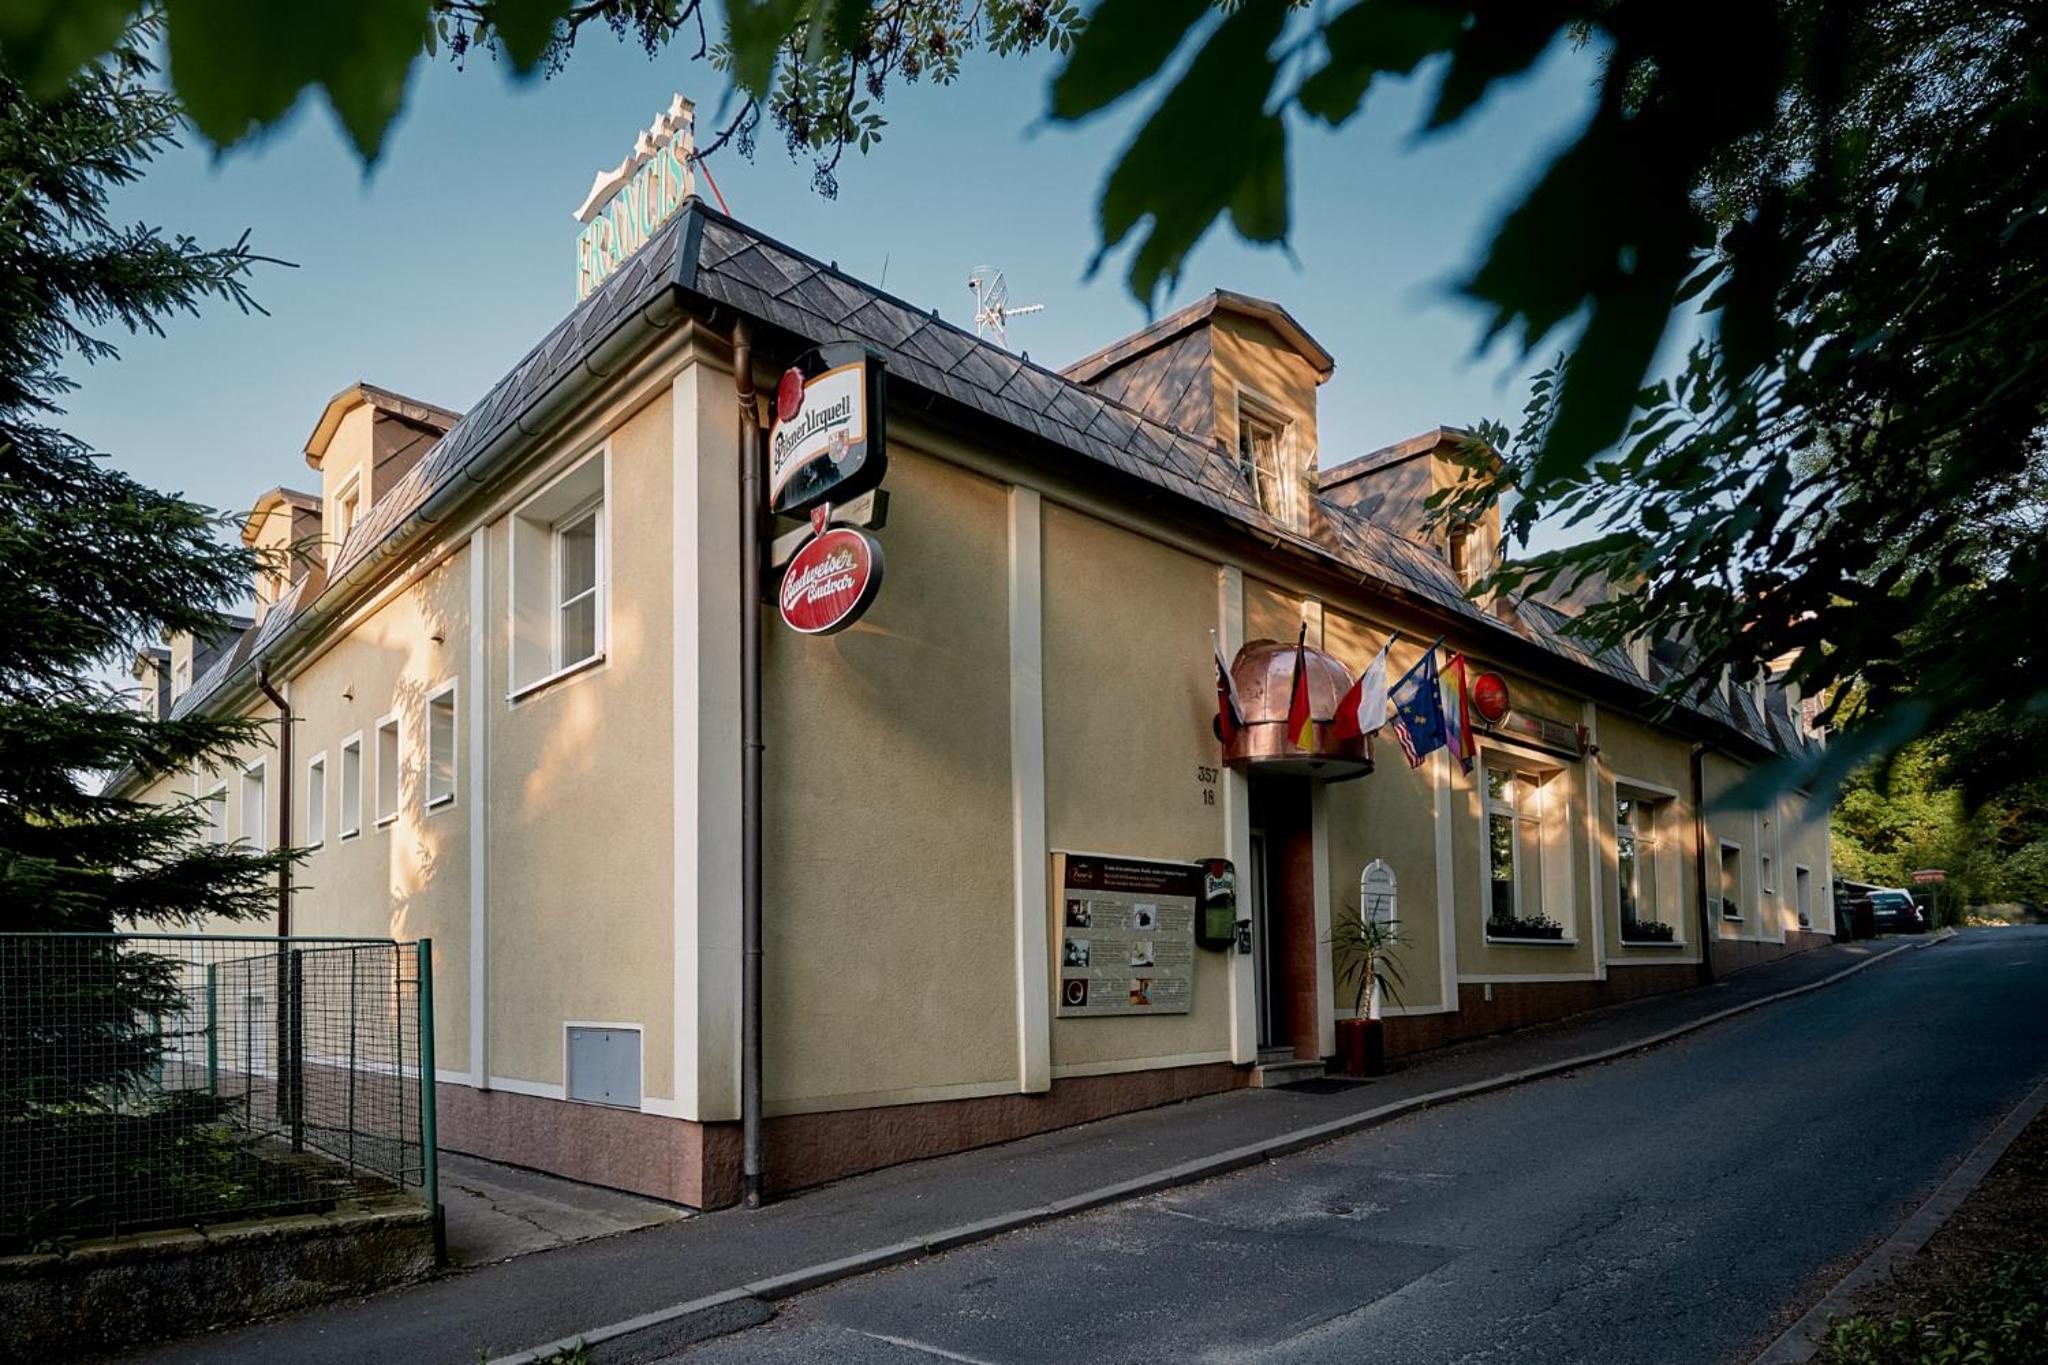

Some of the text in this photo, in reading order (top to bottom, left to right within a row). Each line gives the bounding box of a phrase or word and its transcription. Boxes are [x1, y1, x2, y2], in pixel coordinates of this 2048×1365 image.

[575, 128, 691, 304] FRANCIS
[774, 394, 850, 475] Pilsner Urquell
[784, 549, 858, 609] Budweiser
[807, 574, 855, 604] Budvar
[1198, 766, 1219, 784] 357
[1203, 789, 1215, 806] 18
